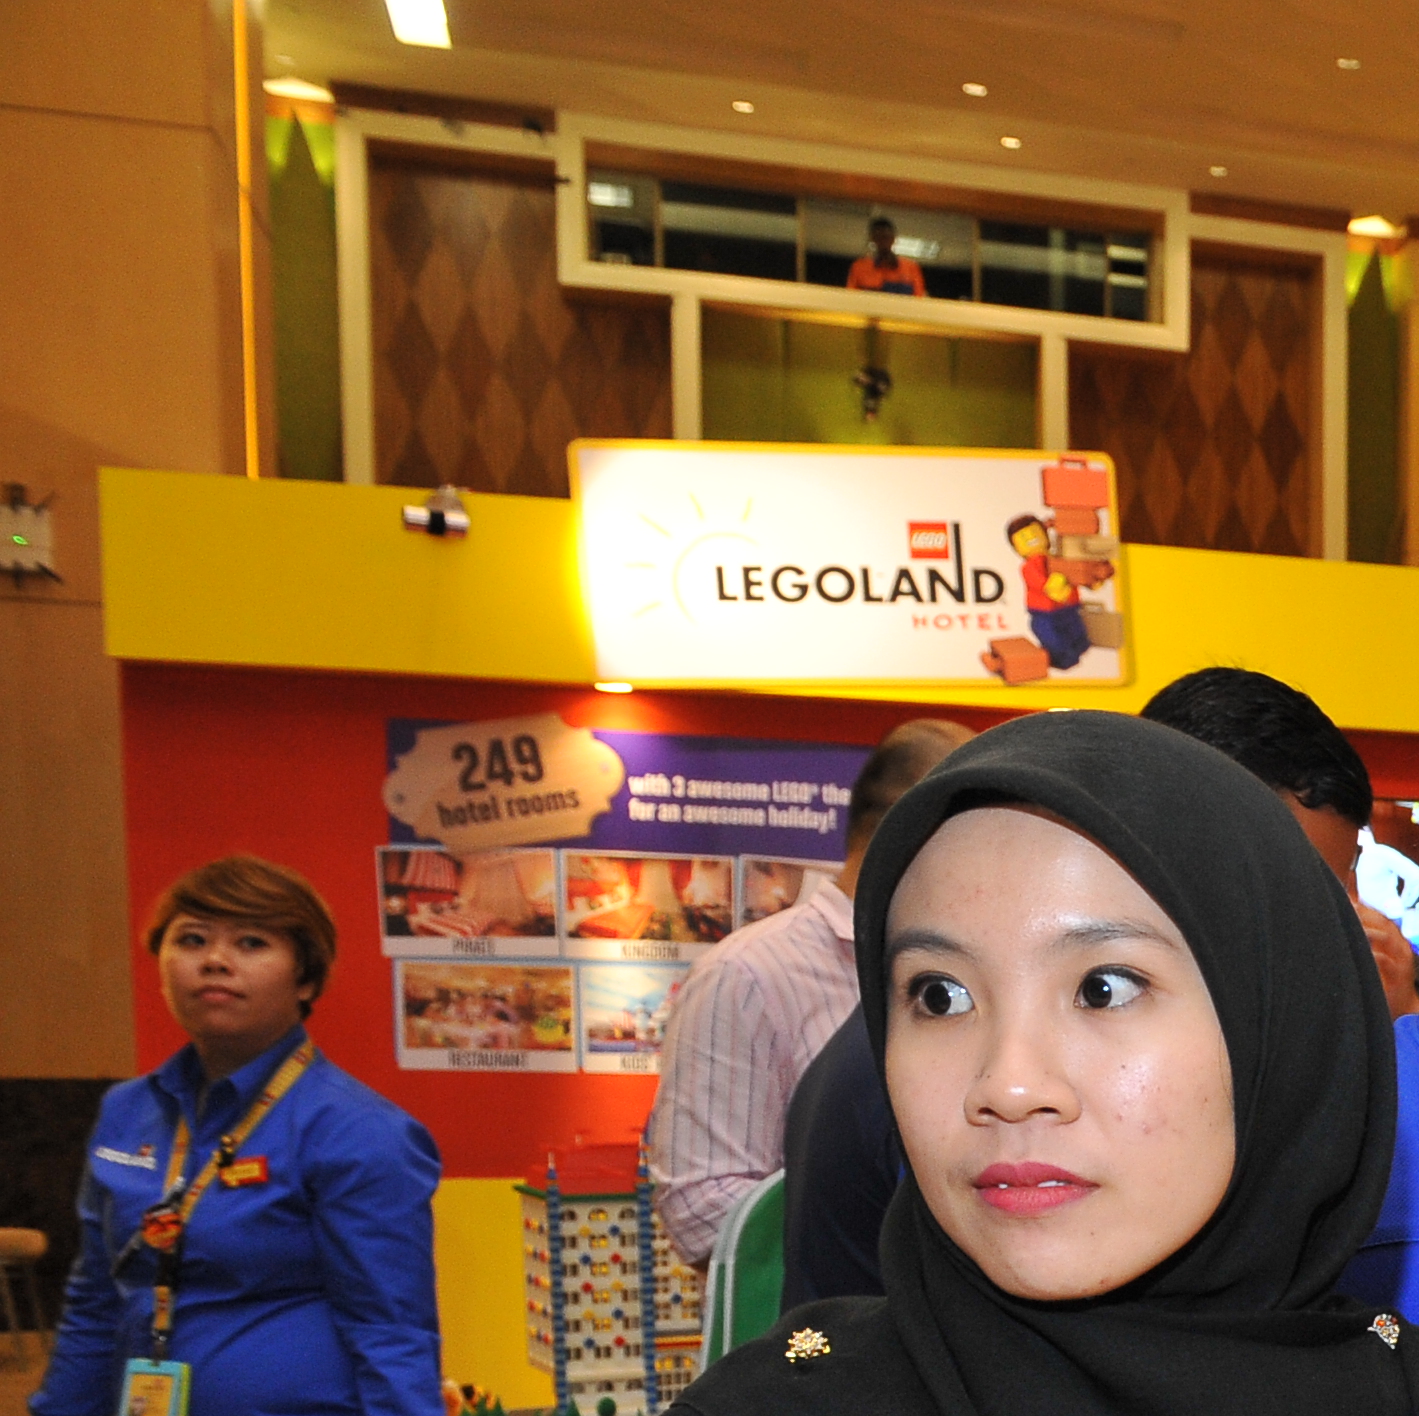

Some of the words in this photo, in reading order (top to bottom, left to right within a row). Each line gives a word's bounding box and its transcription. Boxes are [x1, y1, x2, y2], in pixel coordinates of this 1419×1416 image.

[911, 531, 946, 549] LEGO
[716, 521, 1005, 604] LEGOLAND
[913, 613, 1009, 631] HOTEL
[451, 733, 544, 794] 249
[628, 773, 671, 797] with
[672, 775, 685, 798] 3
[686, 779, 770, 800] awesome
[437, 795, 500, 829] hotel
[507, 787, 579, 816] rooms
[628, 797, 657, 821] for
[657, 803, 681, 822] an
[682, 804, 766, 827] awesome
[768, 804, 837, 834] holiday!
[447, 1051, 529, 1068] RESTAURANT
